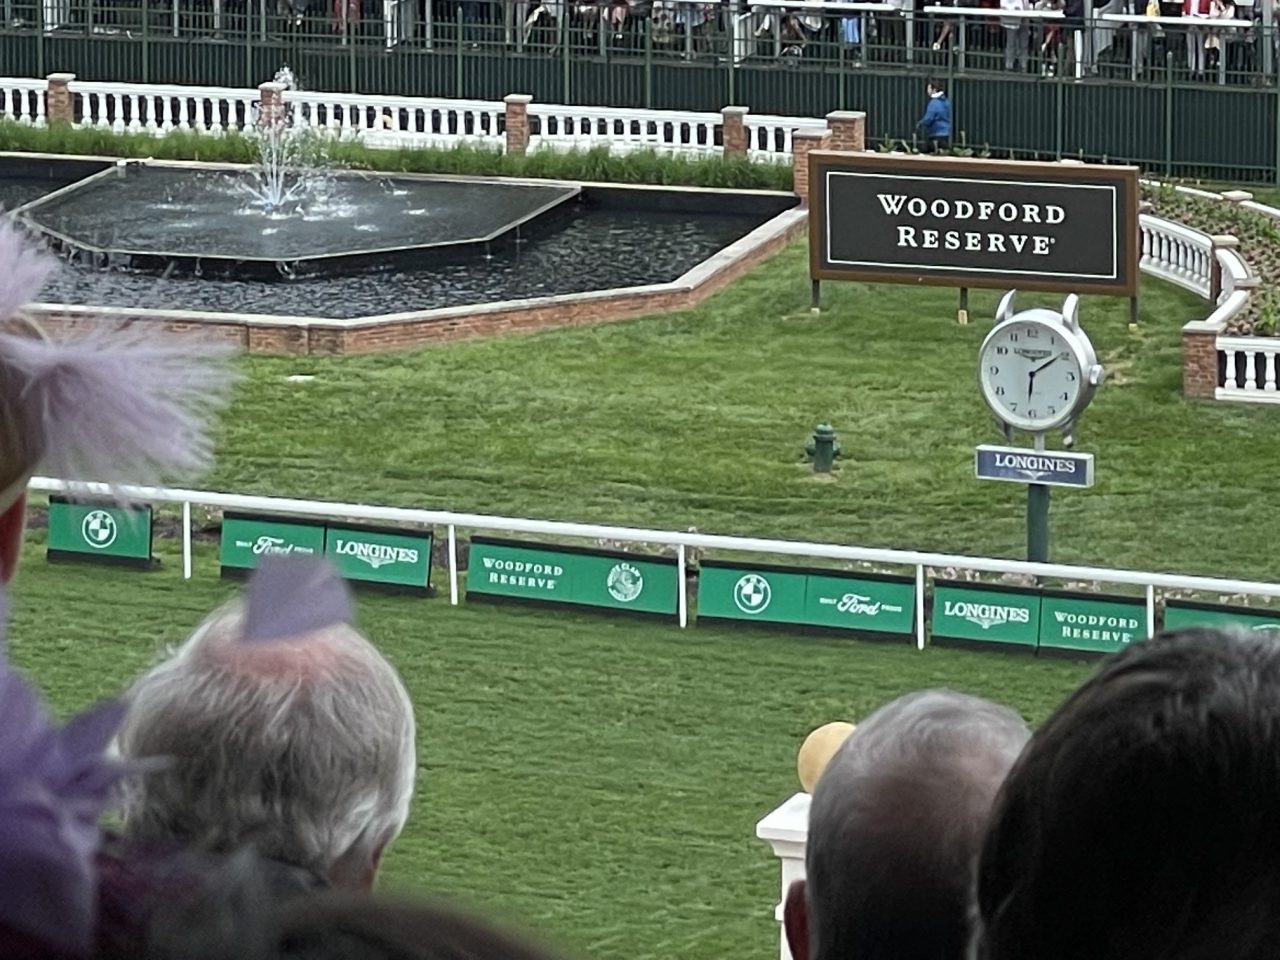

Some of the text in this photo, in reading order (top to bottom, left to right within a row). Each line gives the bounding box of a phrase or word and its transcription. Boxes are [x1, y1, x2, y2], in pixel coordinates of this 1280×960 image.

[877, 194, 1066, 224] WOODFORD
[897, 226, 1051, 255] RESERVE
[995, 454, 1075, 473] LONGINES
[336, 539, 418, 563] LONGINES
[482, 557, 564, 576] WOODFORD
[489, 573, 556, 590] RESERVE
[837, 593, 881, 615] Ford
[944, 601, 1030, 623] LONGINES
[1054, 611, 1139, 629] WOODFORD
[1062, 626, 1132, 643] RESERVE
